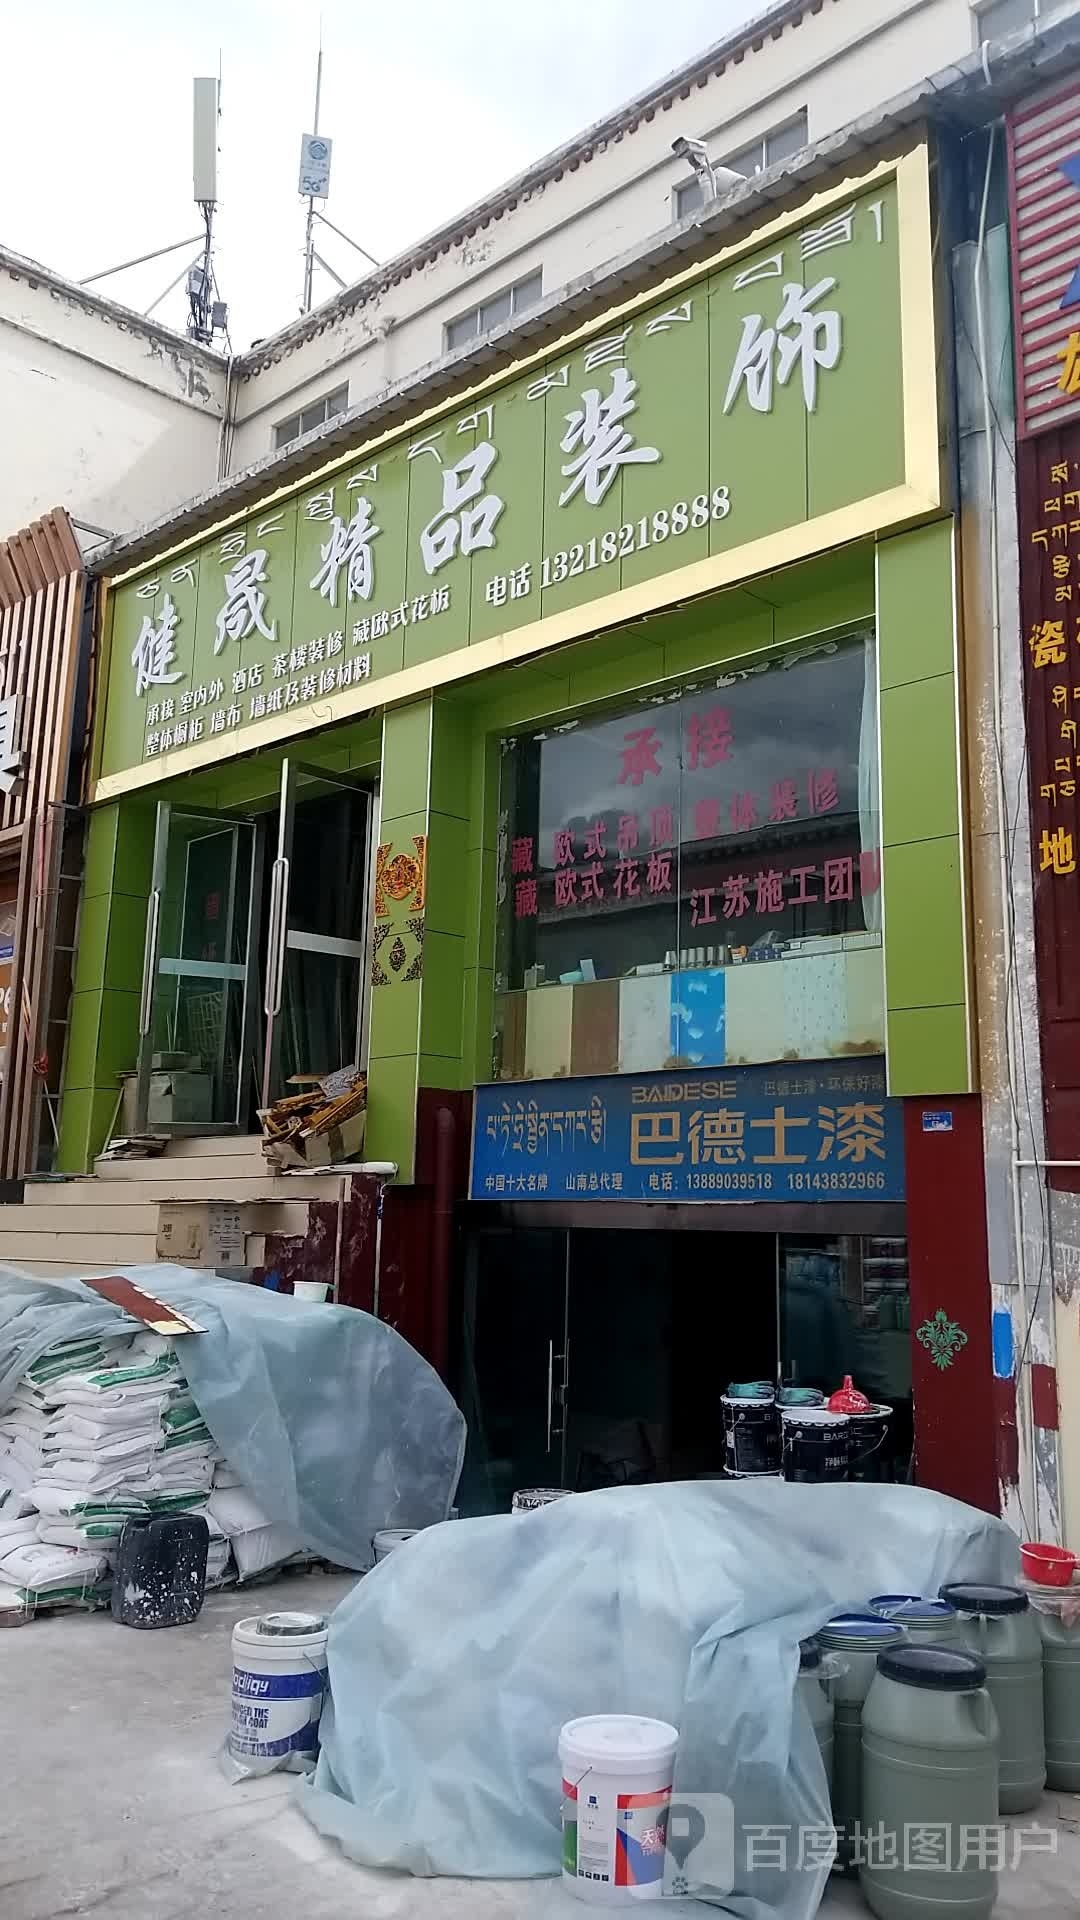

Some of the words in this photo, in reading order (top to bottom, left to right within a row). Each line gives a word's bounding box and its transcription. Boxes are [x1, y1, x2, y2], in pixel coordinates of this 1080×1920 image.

[131, 277, 842, 696] 健晟精品装饰
[485, 562, 532, 607] 电话
[540, 486, 732, 589] 13218218888
[146, 698, 175, 727] 承接
[179, 678, 225, 716] 室内外
[232, 663, 265, 694] 酒店
[272, 630, 344, 679] 茶楼装修
[352, 584, 451, 646] 藏欧式花板
[145, 716, 205, 757] 整体橱柜
[210, 704, 242, 734] 墙布
[249, 652, 371, 720] 墙纸及装修材料
[617, 705, 736, 786] 承接
[515, 879, 537, 919] 藏
[555, 850, 673, 908] 欧式花板
[1039, 826, 1076, 874] 地
[630, 1101, 887, 1167] 巴德士漆
[485, 1173, 549, 1192] 中国十大名牌
[565, 1172, 623, 1191] 山南总代理
[686, 1172, 773, 1190] 13889039518
[787, 1171, 885, 1190] 18143832966
